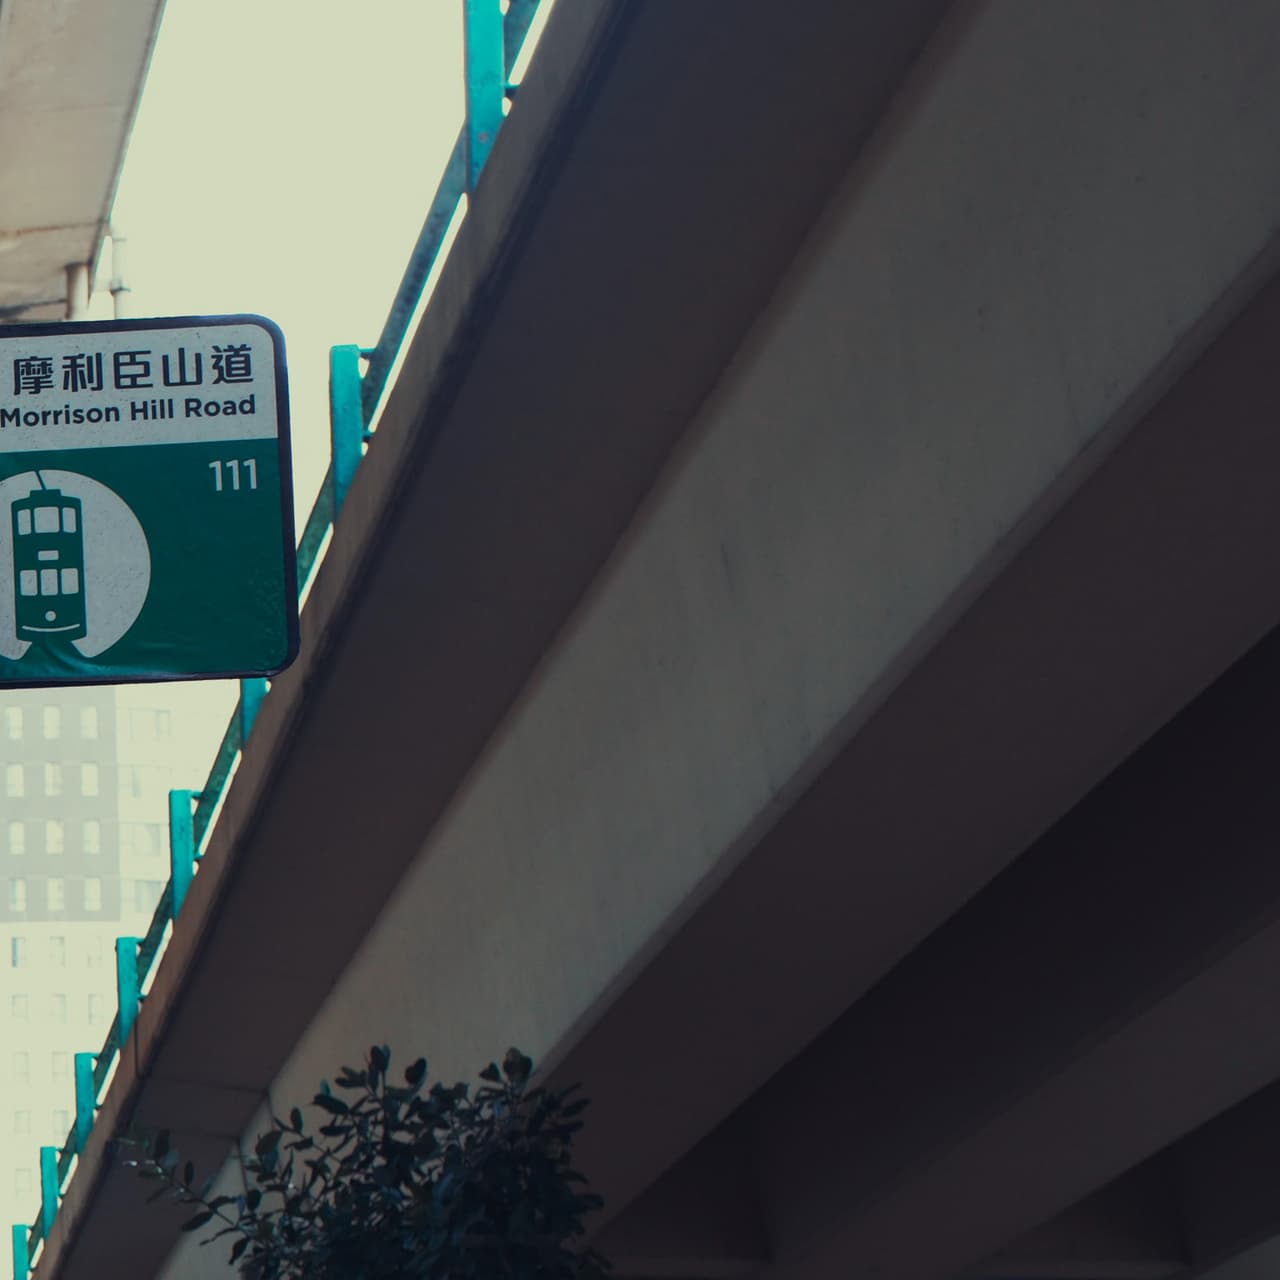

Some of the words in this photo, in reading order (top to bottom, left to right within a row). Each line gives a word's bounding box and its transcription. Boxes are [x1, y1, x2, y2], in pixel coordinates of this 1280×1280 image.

[13, 343, 255, 396] 摩利臣山道
[0, 404, 120, 428] Morrison
[130, 398, 174, 421] Hill
[184, 394, 257, 418] Road
[208, 458, 258, 491] 111
